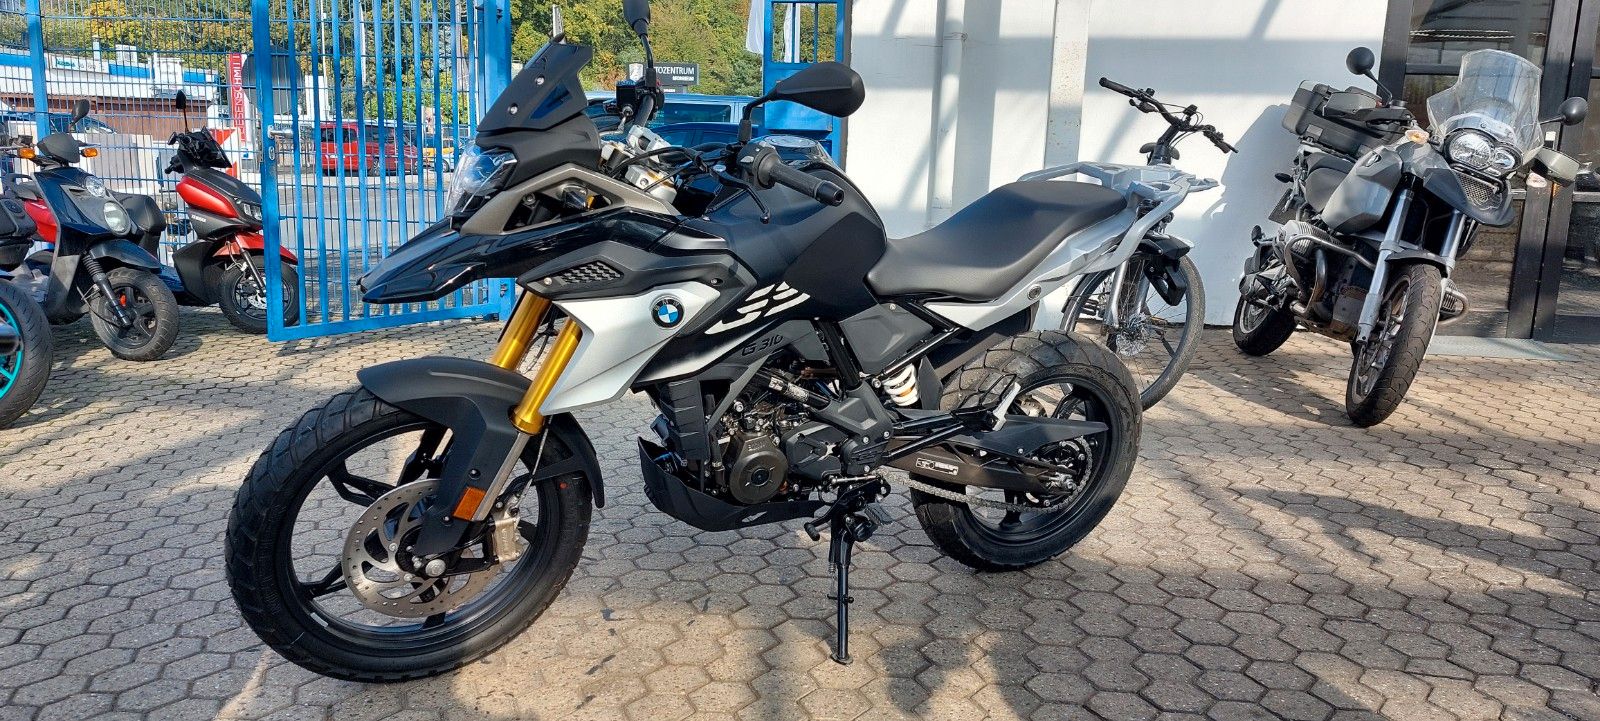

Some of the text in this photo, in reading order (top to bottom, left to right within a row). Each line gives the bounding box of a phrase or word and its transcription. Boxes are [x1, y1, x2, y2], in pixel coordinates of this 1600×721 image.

[653, 66, 695, 75] TOZENTRUM
[741, 335, 784, 356] G 310
